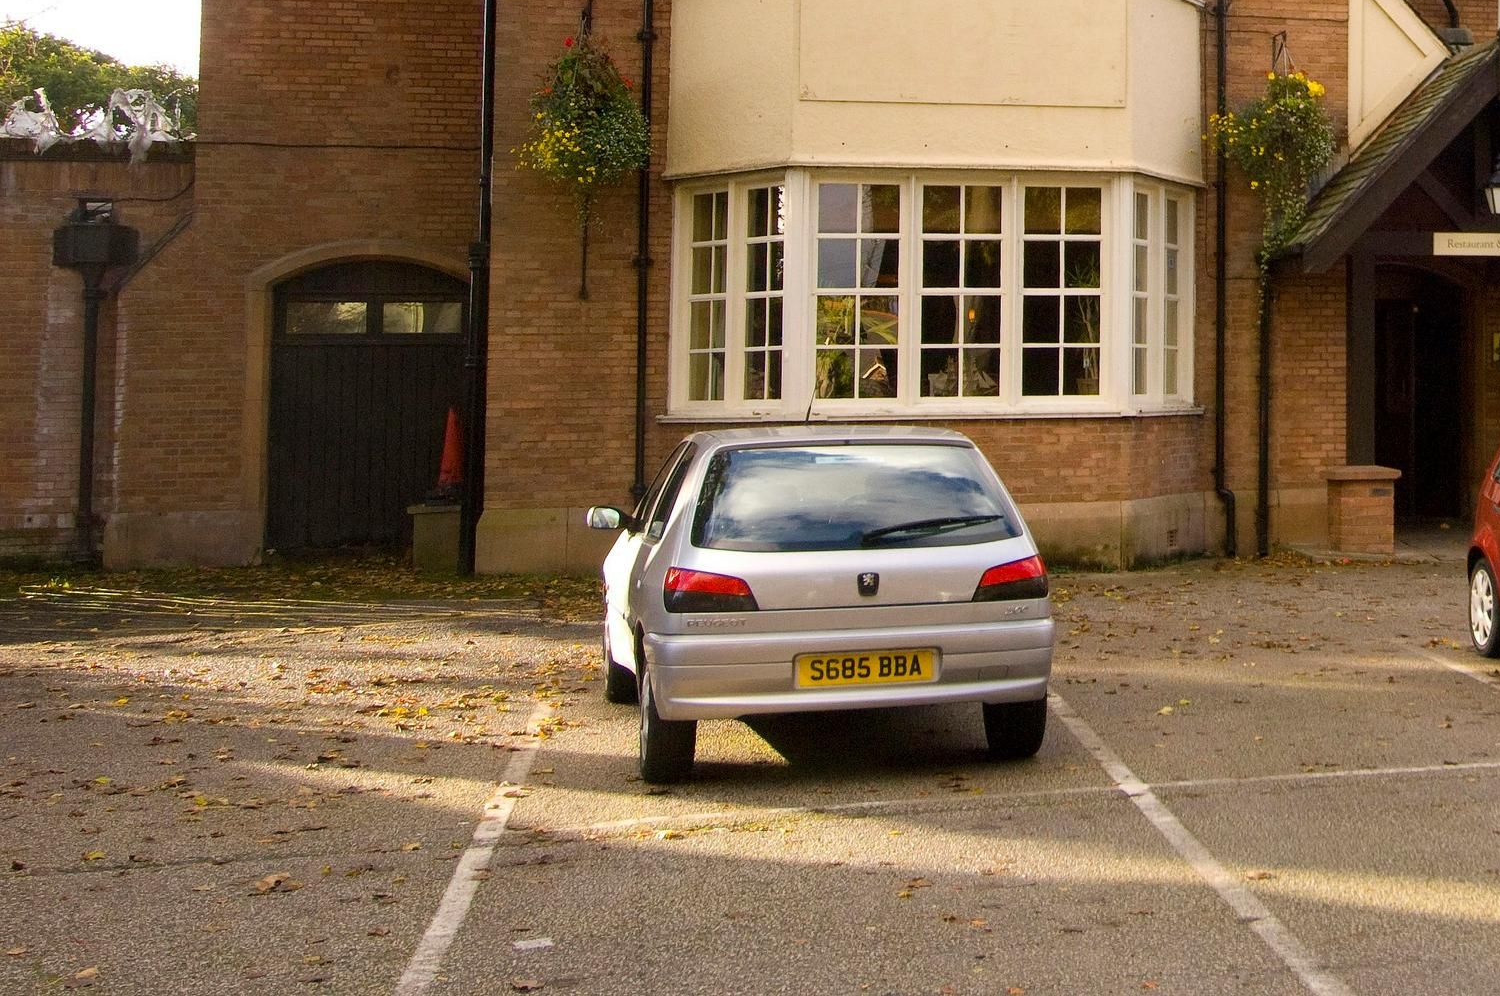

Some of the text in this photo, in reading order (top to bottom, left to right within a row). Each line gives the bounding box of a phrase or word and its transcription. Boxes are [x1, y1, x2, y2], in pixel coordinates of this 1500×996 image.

[1447, 238, 1494, 249] Restaurant
[687, 617, 746, 628] PEUGEOT
[810, 654, 922, 681] S685 BBA
